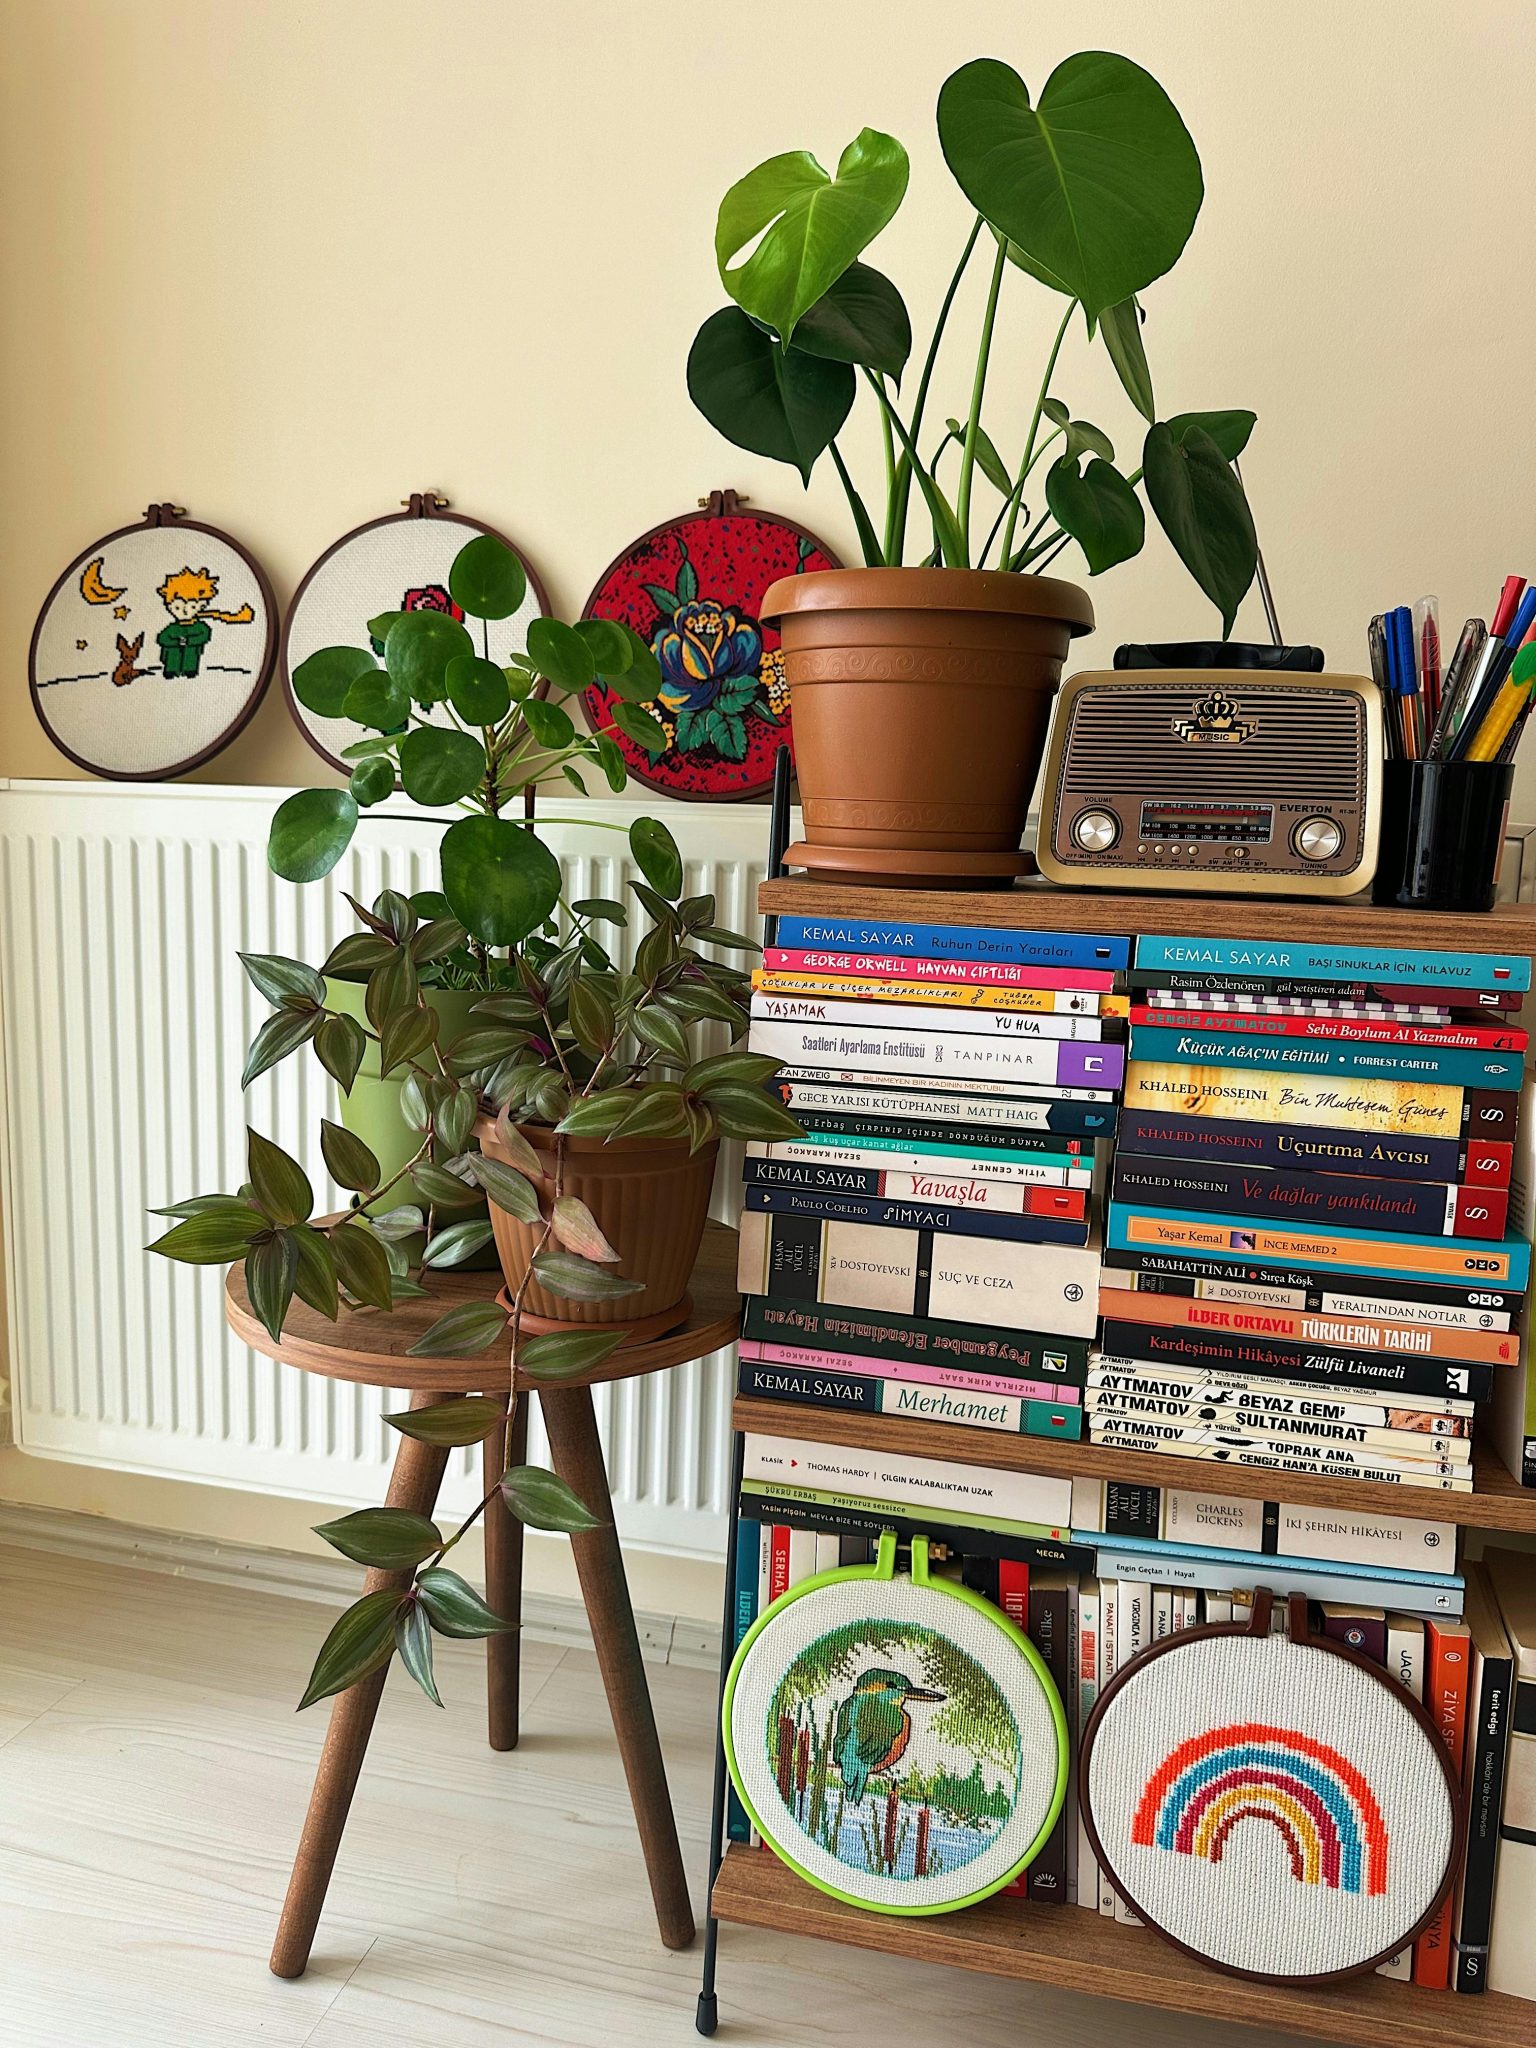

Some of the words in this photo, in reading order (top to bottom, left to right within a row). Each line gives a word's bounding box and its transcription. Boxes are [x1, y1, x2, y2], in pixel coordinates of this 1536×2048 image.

[1198, 733, 1230, 741] MUSIC
[1280, 804, 1332, 814] EVERTON
[802, 927, 856, 942] KEMAL
[860, 931, 914, 946] SAYAR
[932, 937, 972, 950] Ruhun
[978, 940, 1013, 953] Derin
[1018, 943, 1072, 956] Yaraları
[803, 954, 850, 968] GEORGE
[856, 958, 907, 972] ORWELL
[916, 962, 966, 977] HAYVAN
[1164, 948, 1223, 963] KEMAL
[1230, 951, 1290, 967] SAYAR
[1308, 958, 1333, 968] BAŞI
[1335, 960, 1390, 972] SINUKLAR
[1393, 962, 1416, 973] İÇİN
[1422, 964, 1472, 976] KILAVUZ
[878, 987, 962, 998] MEZARLIKLARI
[1170, 976, 1203, 988] Rasim
[1206, 975, 1265, 991] Özdenören
[1276, 982, 1292, 993] gül
[1293, 984, 1335, 995] yetiştiren
[1338, 986, 1365, 996] adam
[994, 998, 1042, 1006] COŞKUNER
[766, 1001, 826, 1018] YAŞAMAK
[995, 1016, 1011, 1029] YU
[1016, 1019, 1040, 1034] HUA
[1146, 1013, 1201, 1025] CENGİZ
[1204, 1017, 1288, 1032] AYTMATOV
[1306, 1023, 1336, 1036] Selvi
[1340, 1025, 1391, 1041] Boylum
[1393, 1029, 1409, 1041] Al
[1413, 1030, 1478, 1045] Yazmalım
[802, 1036, 837, 1052] Saatleri
[840, 1038, 880, 1057] Ayarlama
[883, 1042, 925, 1058] Enstitüsü
[954, 1050, 1033, 1064] TANPINAR
[1282, 1050, 1329, 1064] EĞİTİMİ
[1353, 1056, 1398, 1068] FORREST
[1400, 1059, 1439, 1070] CARTER
[801, 1070, 830, 1079] ZWEIG
[863, 1075, 911, 1085] BİLİNMEYEN
[912, 1078, 926, 1086] BİR
[928, 1080, 963, 1088] KADININ
[964, 1084, 1004, 1092] MEKTUBU
[798, 1093, 828, 1104] GECE
[832, 1096, 870, 1107] YARISI
[873, 1096, 960, 1114] KÜTÜPHANESİ
[967, 1106, 1003, 1118] MATT
[1006, 1109, 1038, 1121] HAIG
[814, 1118, 845, 1130] Erbaş
[856, 1124, 902, 1134] ÇIRPINIP
[906, 1127, 943, 1138] İÇİNDE
[949, 1130, 1005, 1144] DÖNDÜĞÜM
[1010, 1138, 1046, 1148] DÜNYA
[823, 1134, 838, 1145] kuş
[841, 1138, 860, 1147] uçar
[862, 1139, 888, 1149] kanat
[891, 1142, 914, 1151] ağlar
[1137, 1127, 1195, 1142] KHALED
[1198, 1134, 1264, 1148] HOSSEINI
[1277, 1136, 1363, 1158] Uçurtma
[1370, 1144, 1430, 1164] Avcısı
[788, 1146, 830, 1157] KARAKOÇ
[1458, 1153, 1466, 1170] ROMAN
[972, 1164, 1011, 1174] CENNET
[1018, 1168, 1046, 1177] YİTİK
[755, 1163, 812, 1183] KEMAL
[816, 1170, 867, 1189] SAYAR
[910, 1176, 988, 1205] Yavaşla
[1122, 1174, 1170, 1187] KHALED
[1173, 1179, 1229, 1193] HOSSEINI
[1242, 1178, 1262, 1198] Ve
[1269, 1184, 1322, 1208] dağlar
[1328, 1193, 1417, 1214] yankılandı
[1158, 1228, 1186, 1240] Yaşar
[1188, 1231, 1223, 1244] Kemal
[1264, 1239, 1288, 1250] İNCE
[1290, 1243, 1330, 1254] MEMED
[774, 1240, 784, 1271] HASAN
[794, 1244, 804, 1271] YÜCEL
[939, 1271, 962, 1284] SUÇ
[965, 1274, 979, 1284] VE
[983, 1277, 1014, 1289] CEZA
[1142, 1257, 1223, 1276] SABAHATTİN
[1226, 1266, 1246, 1278] ALİ
[1260, 1270, 1285, 1283] Sırça
[1288, 1274, 1314, 1286] Köşk
[1188, 1306, 1230, 1323] İLBER
[1234, 1314, 1294, 1334] ORTAYLI
[1301, 1318, 1380, 1346] TÜRKLERİN
[1384, 1329, 1432, 1352] TARİHİ
[780, 1350, 822, 1362] KARAKOÇ
[826, 1357, 853, 1367] SEZAİ
[1150, 1336, 1233, 1358] Kardeşimin
[1237, 1347, 1301, 1367] Hikâyesi
[1304, 1355, 1344, 1374] Zülfü
[1347, 1358, 1406, 1379] Livaneli
[938, 1372, 964, 1382] SAAT
[967, 1376, 991, 1386] KIRK
[995, 1381, 1036, 1393] HIZIRLA
[1100, 1374, 1193, 1399] AYTMATOV
[1238, 1394, 1293, 1413] BEYAZ
[1300, 1401, 1346, 1419] GEMİ
[1097, 1392, 1190, 1416] AYTMATOV
[1235, 1412, 1368, 1442] SULTANMURAT
[761, 1456, 784, 1464] KLASİK
[808, 1463, 840, 1474] THOMAS
[843, 1468, 869, 1478] HARDY
[881, 1474, 906, 1484] ÇILGIN
[909, 1476, 968, 1493] KALABALIKTAN
[971, 1487, 993, 1497] UZAK
[765, 1486, 791, 1496] ŞÜKRÜ
[793, 1489, 817, 1501] ERBAŞ
[832, 1497, 871, 1508] yaşıyoruz
[873, 1502, 906, 1513] sessizce
[1108, 1486, 1119, 1520] HASAN
[1130, 1490, 1141, 1521] YÜCEL
[1196, 1504, 1244, 1517] CHARLES
[761, 1504, 781, 1514] YASİN
[810, 1513, 834, 1522] MEVLA
[836, 1515, 850, 1524] BİZE
[1196, 1515, 1243, 1528] DICKENS
[1036, 1548, 1065, 1560] MECRA
[775, 1549, 786, 1594] SERHAT
[1116, 1564, 1136, 1573] Engin
[1138, 1566, 1163, 1575] Geçtan
[1174, 1570, 1195, 1579] Hayat
[739, 1590, 754, 1624] İLBER
[1106, 1603, 1114, 1636] PANAIT
[1132, 1598, 1140, 1636] VIRGINIA
[1400, 1650, 1412, 1688] JACK
[1443, 1690, 1457, 1723] ZİYA
[1491, 1689, 1501, 1712] ferit
[1489, 1712, 1499, 1736] edgü
[1479, 1808, 1489, 1837] mevsim
